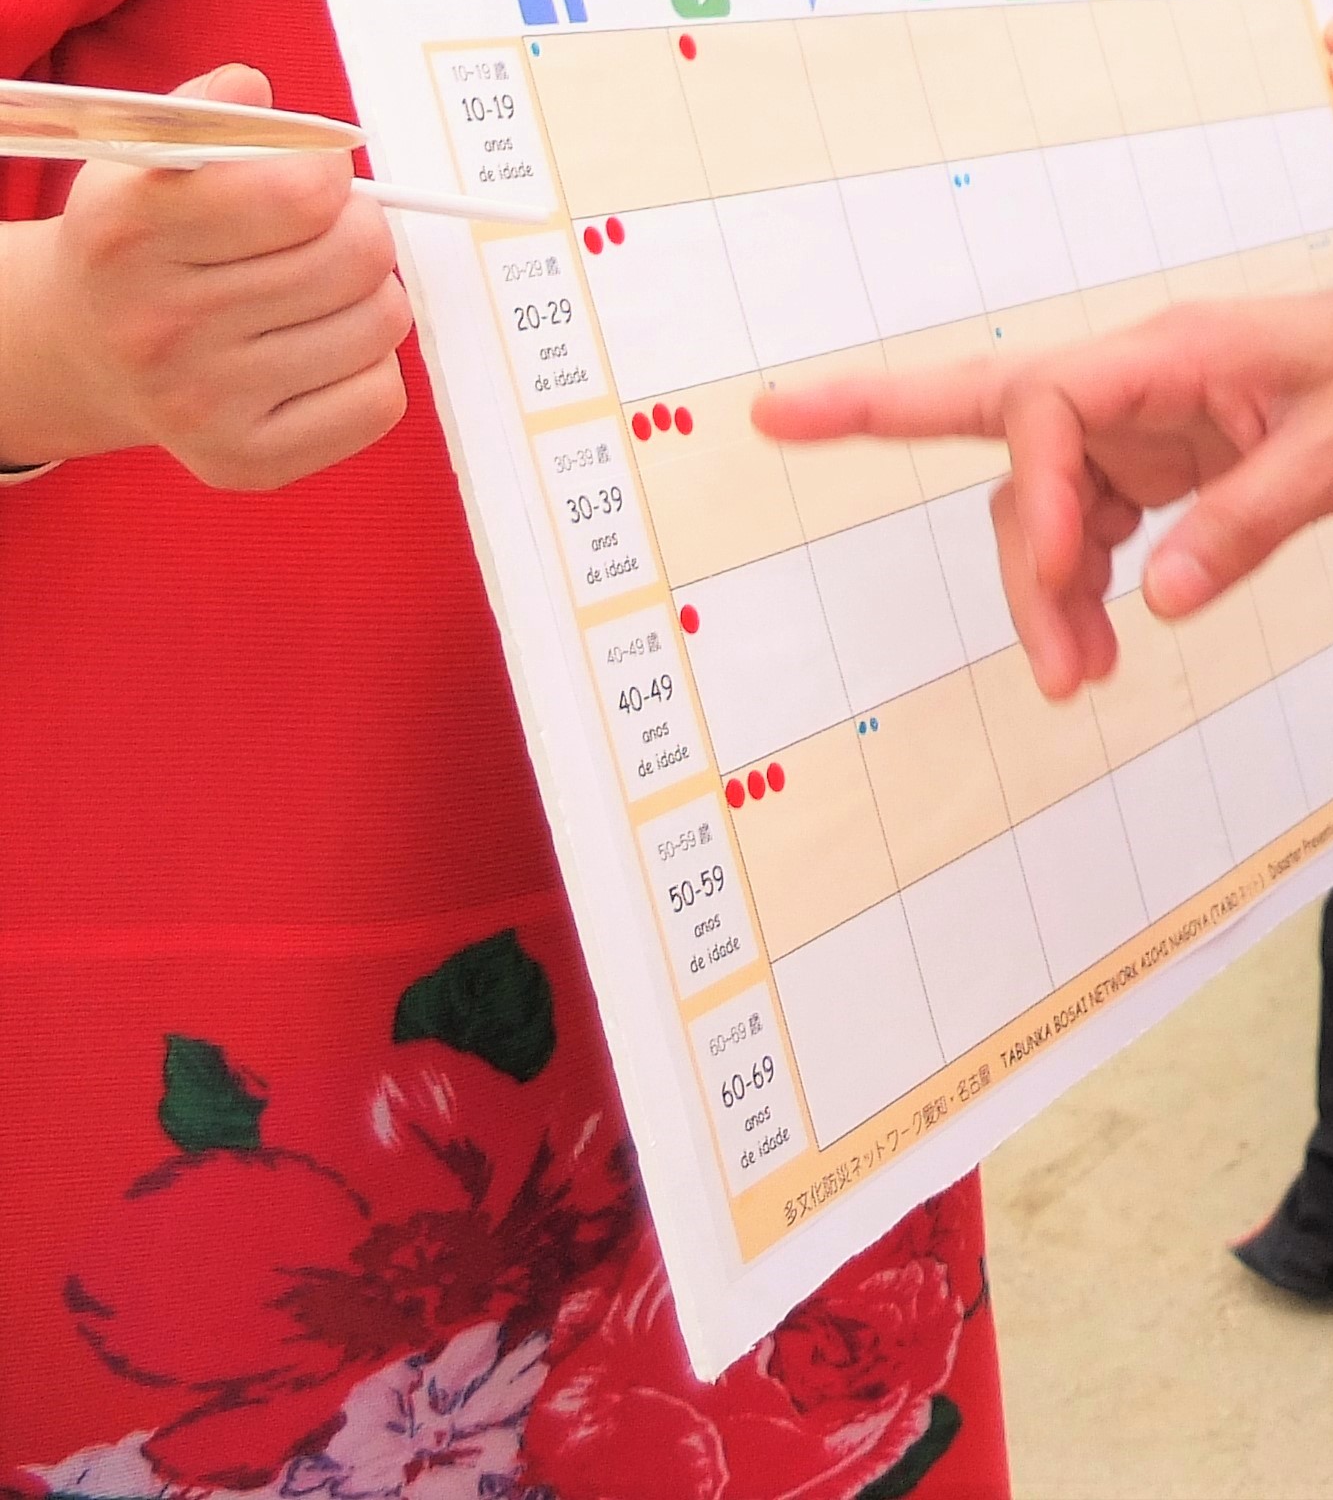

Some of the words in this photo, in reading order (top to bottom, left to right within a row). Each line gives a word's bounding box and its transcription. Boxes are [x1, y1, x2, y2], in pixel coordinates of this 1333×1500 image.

[461, 94, 515, 122] 10-19
[484, 136, 514, 153] anos
[479, 165, 496, 183] de
[498, 162, 534, 180] idade
[514, 298, 573, 332] 20-29
[539, 343, 569, 360] anos
[534, 374, 552, 392] de
[554, 366, 589, 388] idade
[566, 485, 623, 524] 30-39
[591, 532, 619, 552] anos
[586, 567, 603, 585] de
[604, 555, 640, 579] idade
[618, 673, 673, 715] 40-49
[642, 721, 670, 744] anos
[638, 759, 654, 778] de
[656, 744, 690, 771] idade
[668, 864, 725, 914] 50-59
[693, 913, 722, 938] anos
[690, 955, 706, 974] de
[707, 935, 741, 965] idade
[1000, 1022, 1053, 1069] TABUNKA
[1053, 996, 1088, 1035] BOSAI
[1089, 963, 1140, 1008] NETWORK
[721, 1054, 775, 1109] 60-69
[744, 1104, 772, 1132] anos
[740, 1149, 756, 1170] de
[758, 1127, 791, 1158] idade
